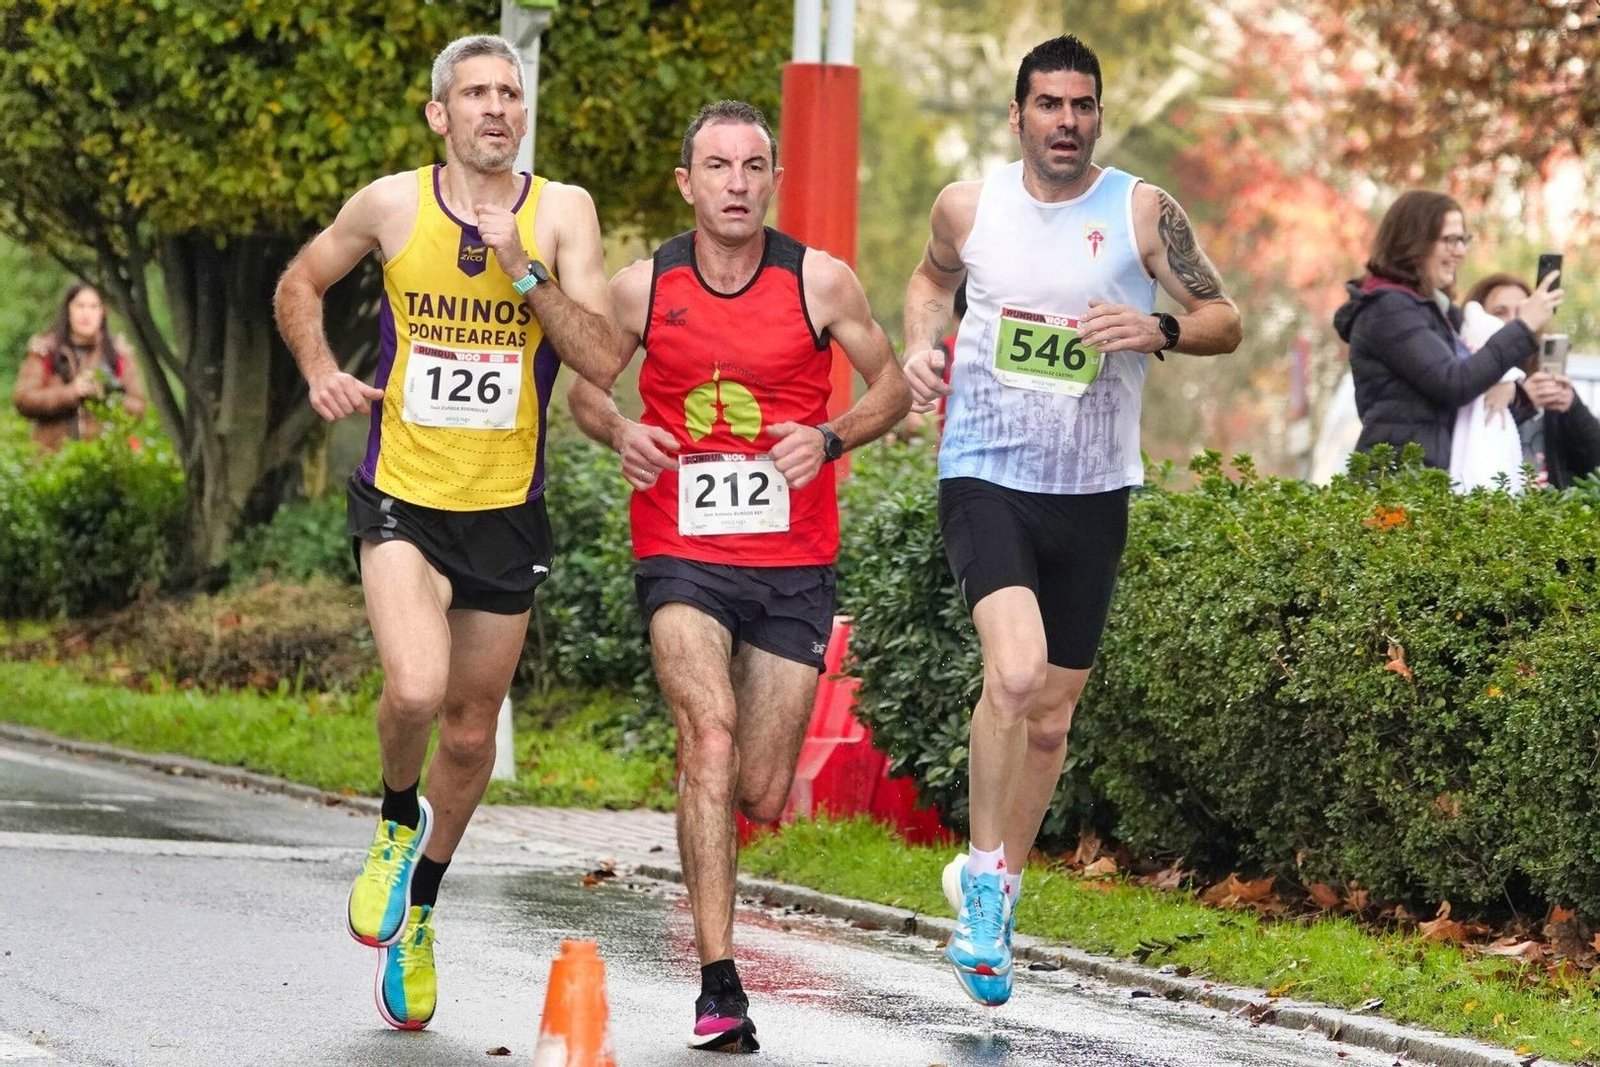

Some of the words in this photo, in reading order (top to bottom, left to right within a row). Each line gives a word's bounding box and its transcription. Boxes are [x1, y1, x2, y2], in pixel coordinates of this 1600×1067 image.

[460, 253, 483, 262] ZICO
[404, 292, 531, 326] TANINOS
[409, 323, 526, 347] PONTEAREAS
[1010, 328, 1086, 370] 546
[426, 366, 501, 405] 126
[709, 360, 754, 380] aletismo
[695, 471, 770, 509] 212
